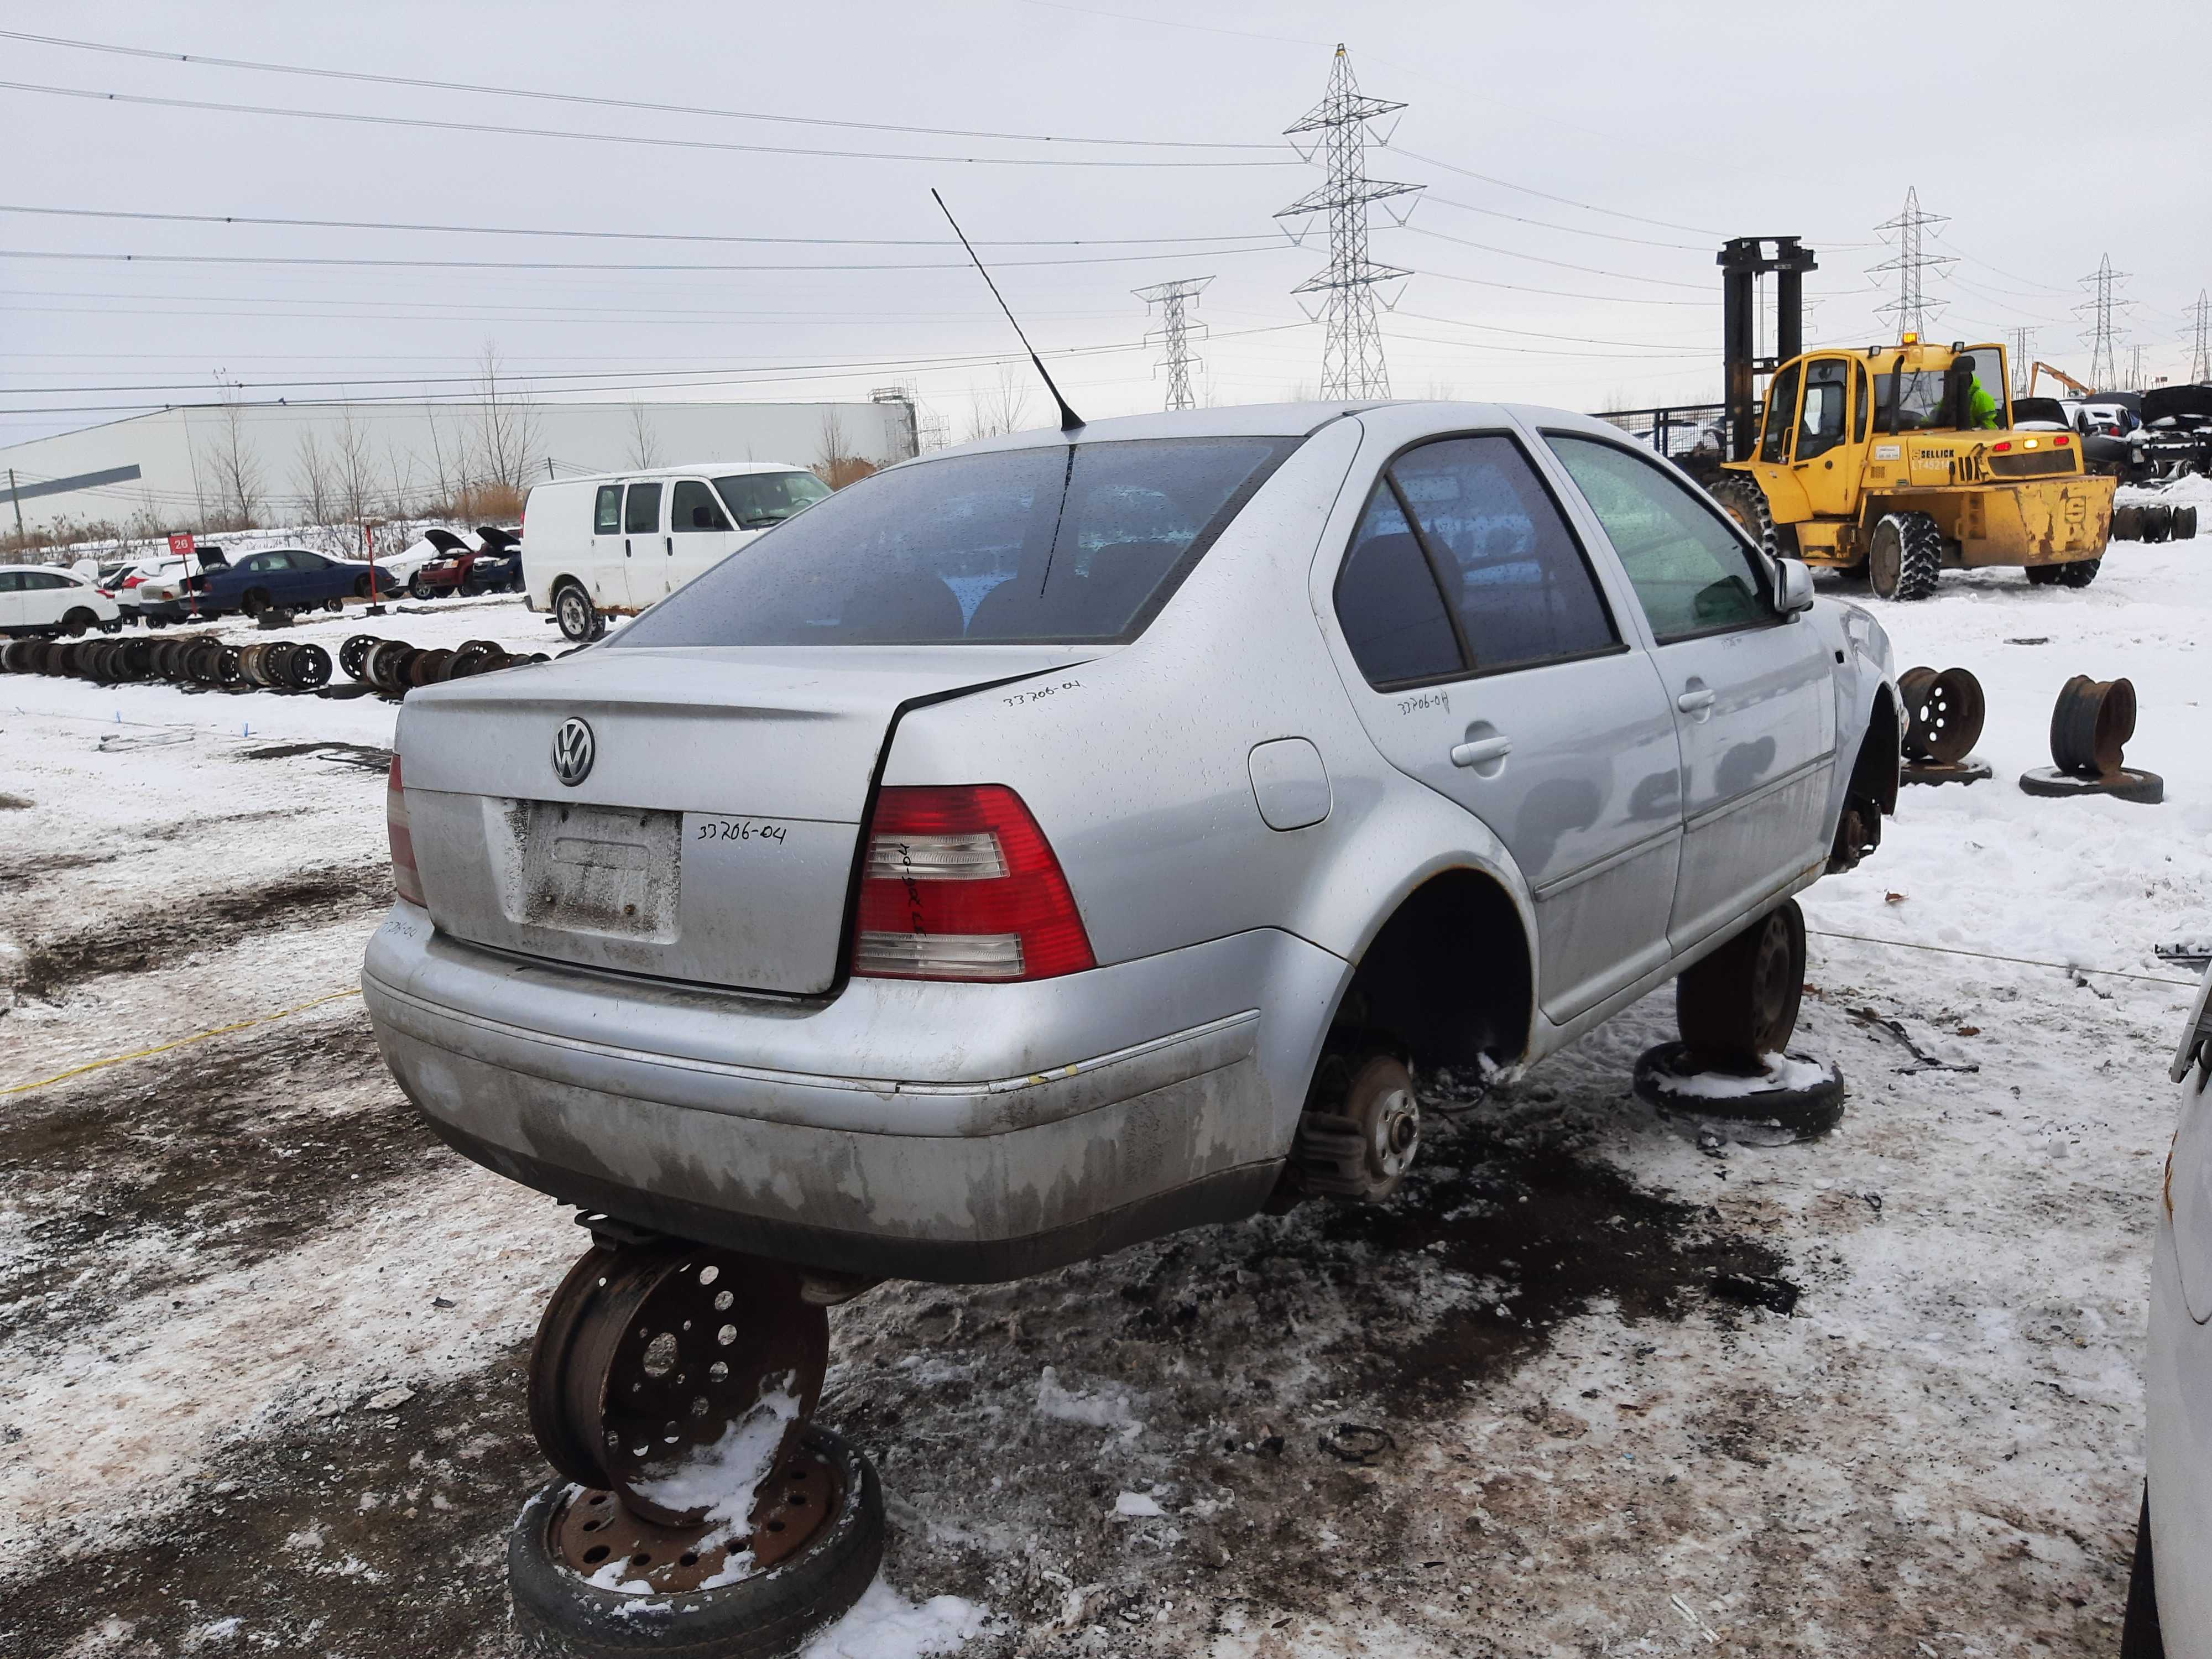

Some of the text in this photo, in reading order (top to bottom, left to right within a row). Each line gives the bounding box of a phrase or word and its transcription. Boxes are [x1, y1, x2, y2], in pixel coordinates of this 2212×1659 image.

[1921, 450, 1955, 458] SELLICK
[1003, 680, 1081, 707] 33206-04
[551, 717, 595, 786] VW
[698, 821, 786, 845] 33206-04
